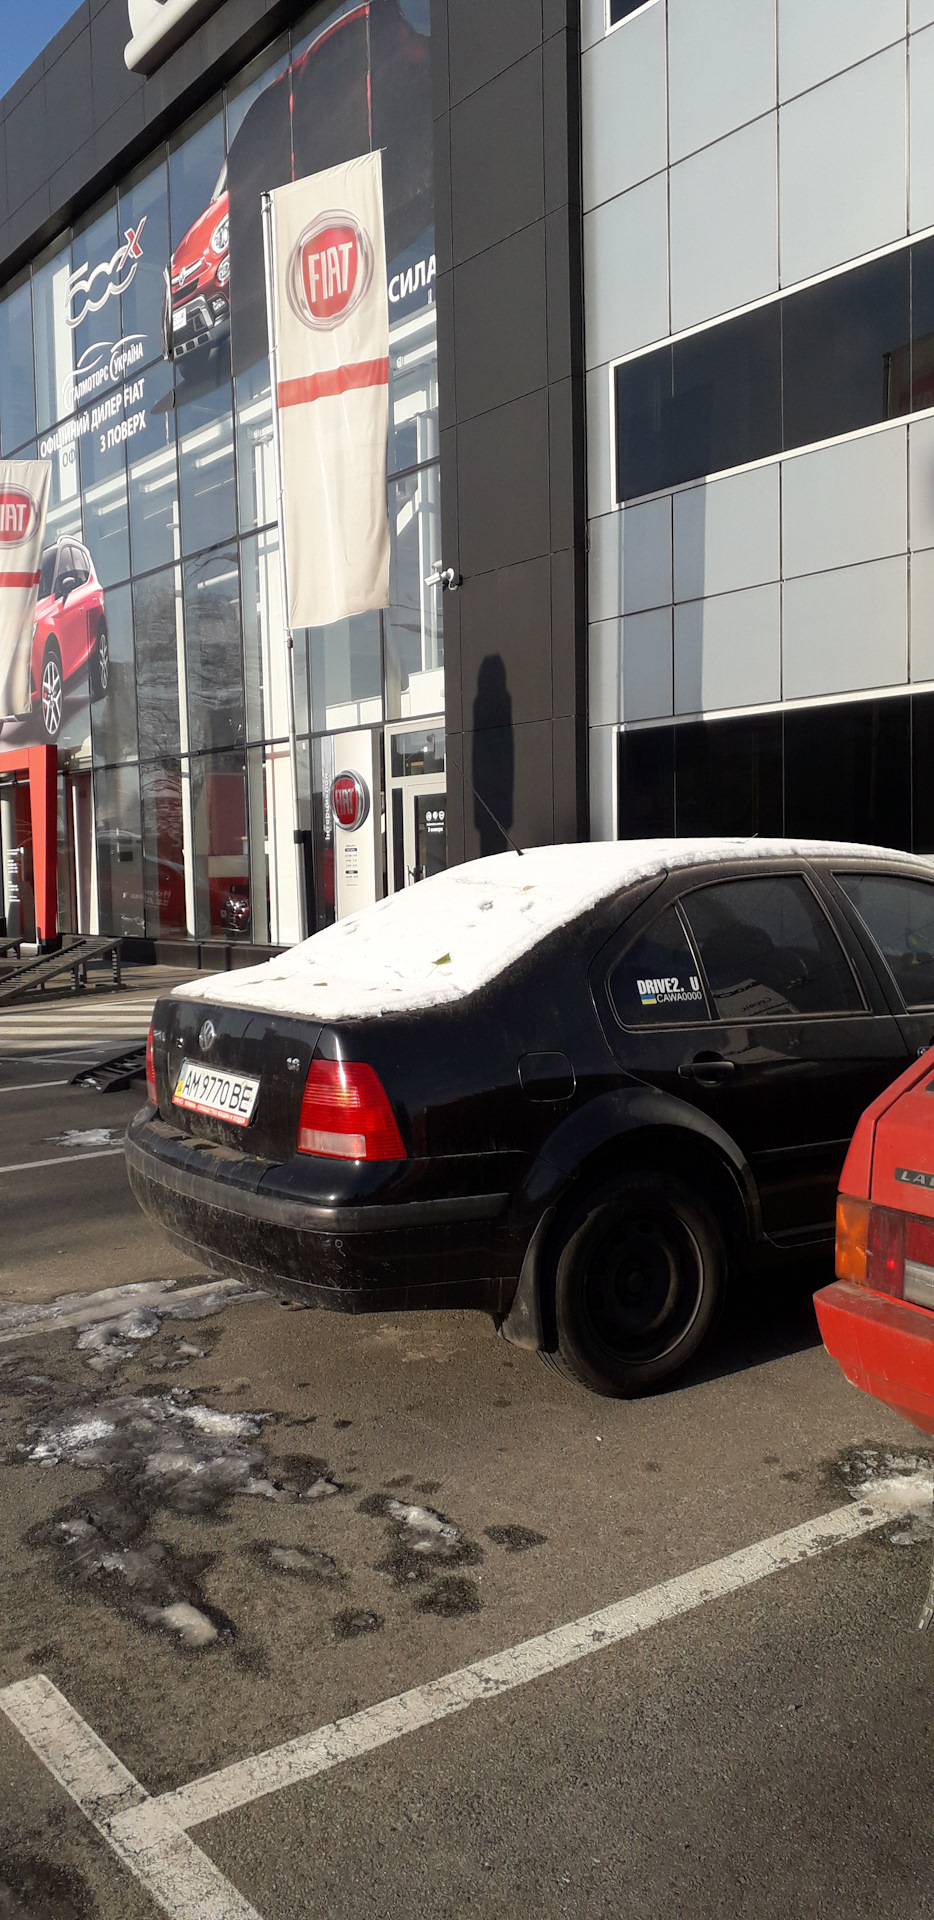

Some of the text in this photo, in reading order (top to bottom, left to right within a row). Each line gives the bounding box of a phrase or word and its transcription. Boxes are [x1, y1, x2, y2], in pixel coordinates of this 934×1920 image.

[307, 241, 353, 303] FIAT
[388, 253, 436, 303] СИЛА
[90, 393, 122, 432] ДИЛЕР
[123, 378, 145, 408] FIAT
[107, 409, 147, 449] ПОВЕРХ
[0, 503, 27, 531] IAT
[335, 788, 354, 815] FIAT
